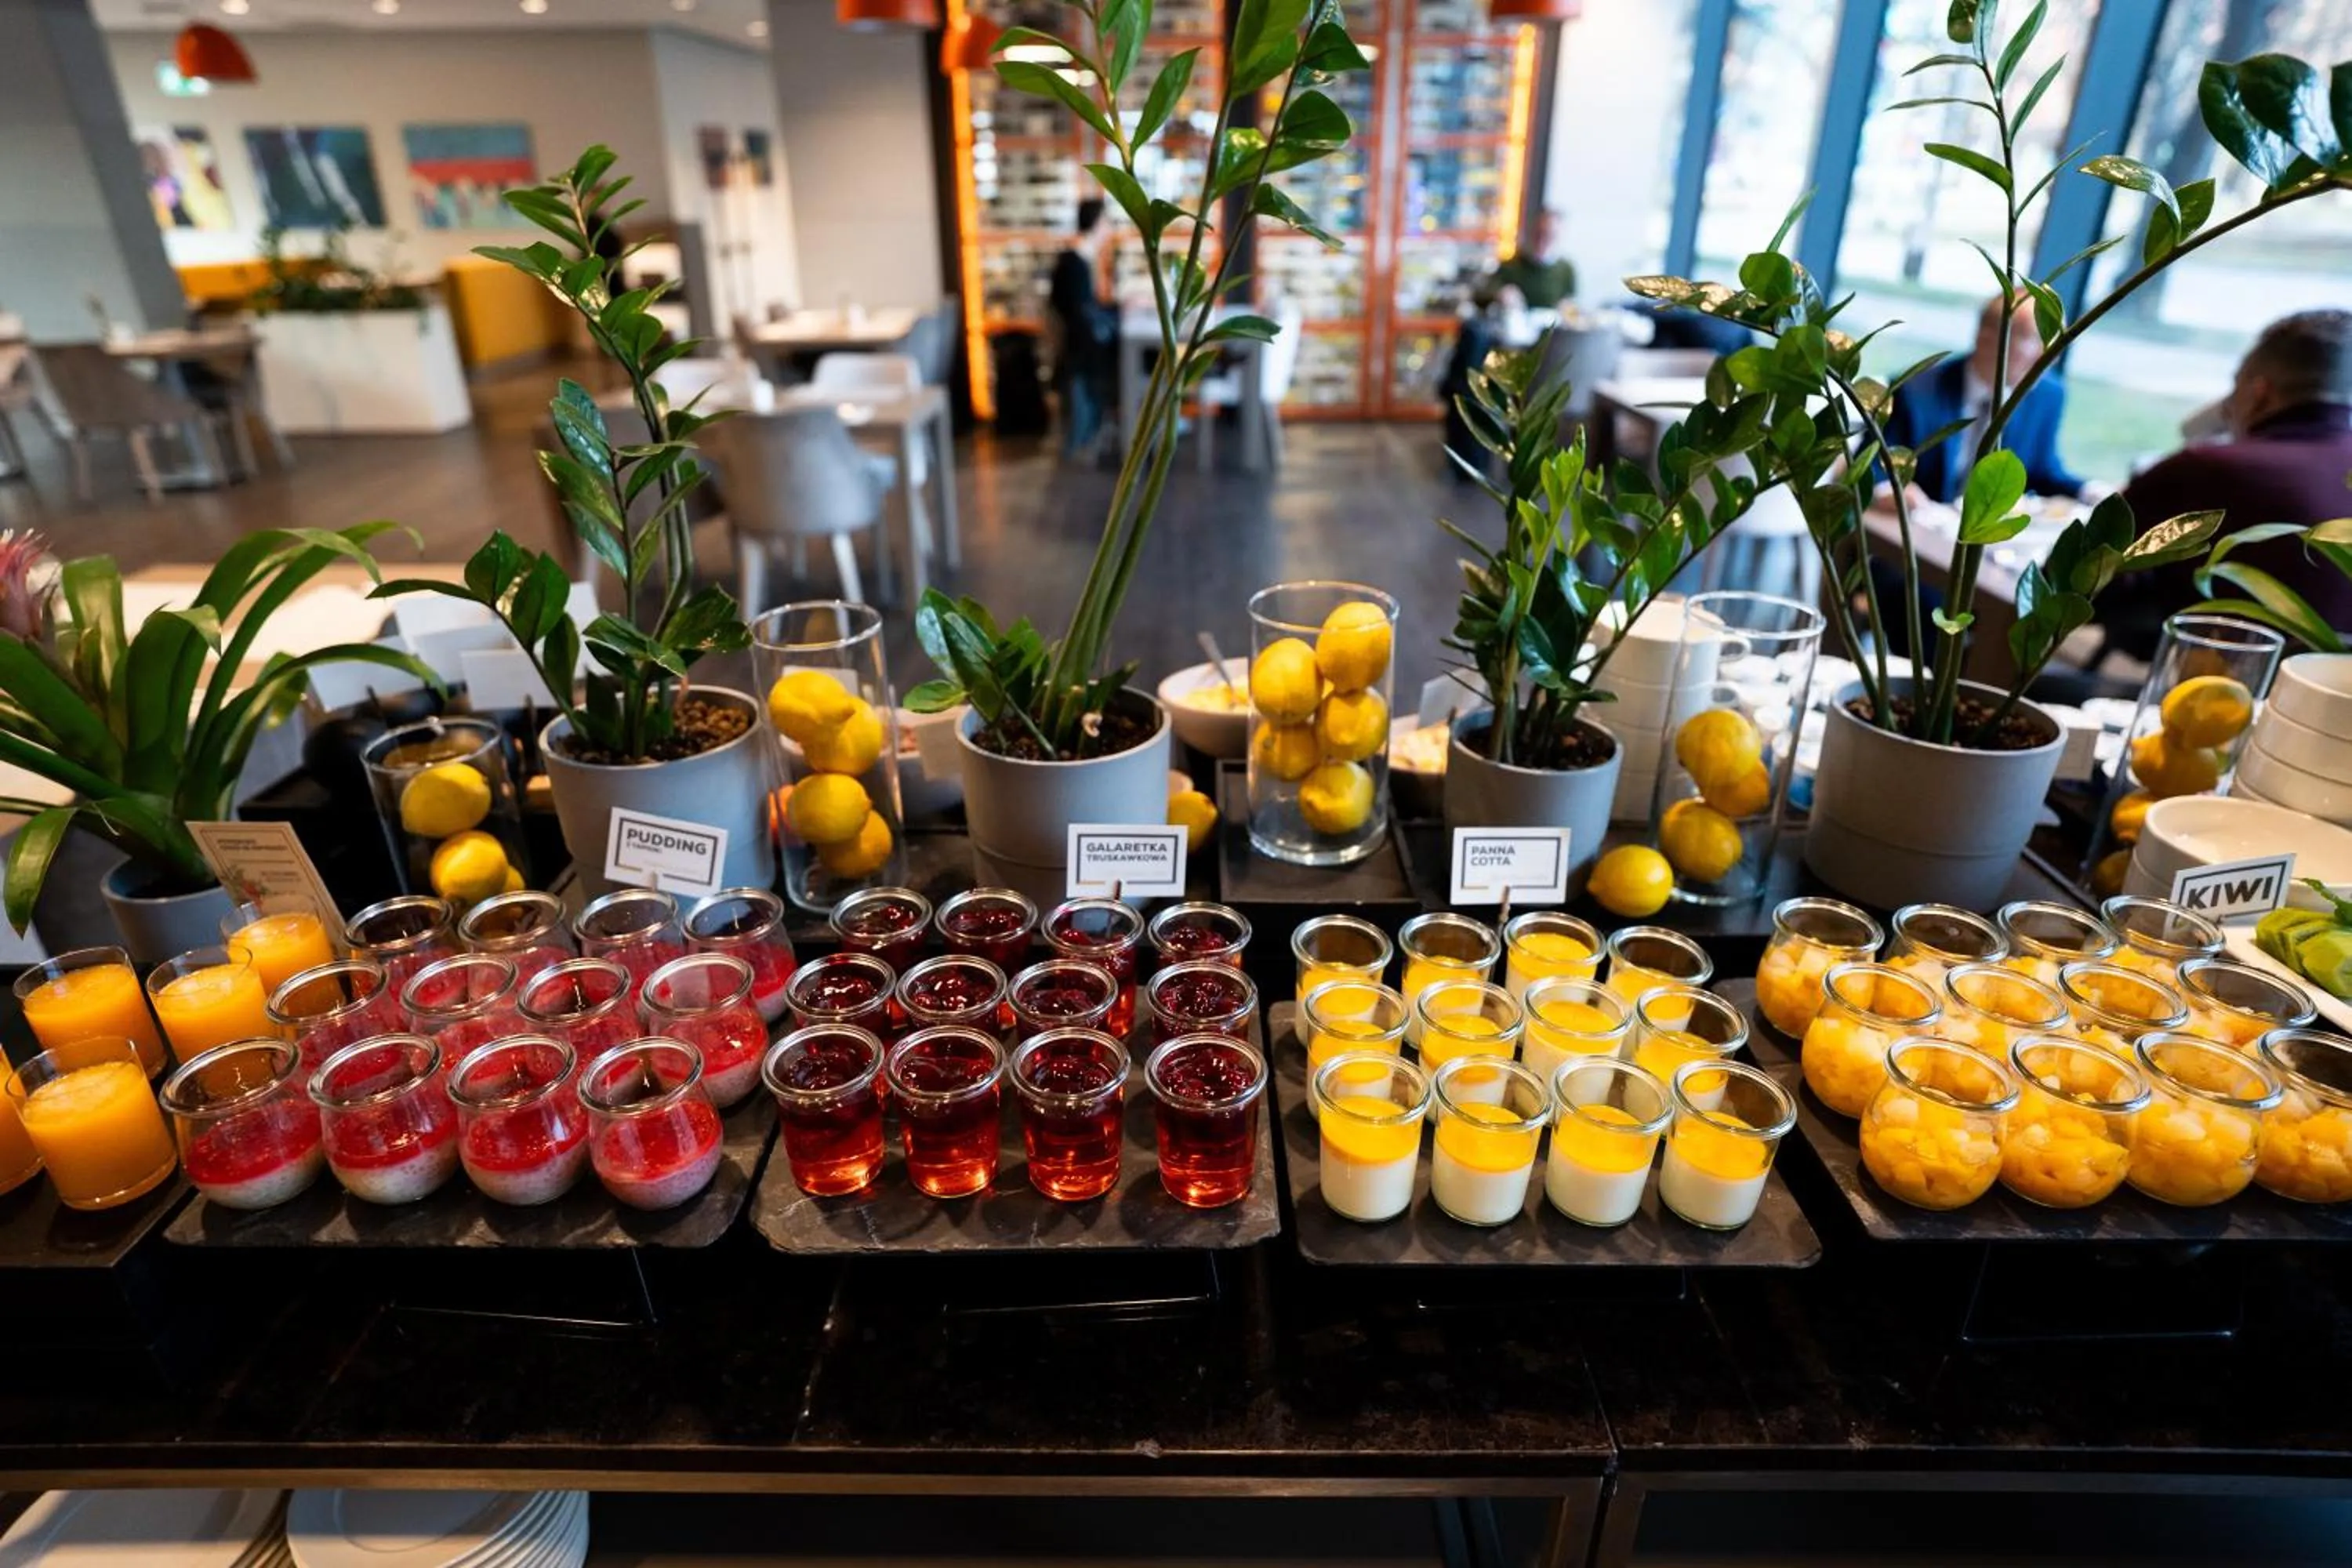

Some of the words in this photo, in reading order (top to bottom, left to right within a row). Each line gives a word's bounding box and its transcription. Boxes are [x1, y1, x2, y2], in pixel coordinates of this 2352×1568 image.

[626, 828, 707, 855] PUDDING
[1086, 843, 1167, 852] GALARETKA
[1471, 845, 1515, 855] PANNA
[1086, 854, 1167, 862] TRUSKAWKOWA
[1471, 856, 1512, 866] COTTA
[2187, 876, 2274, 909] KIWI
